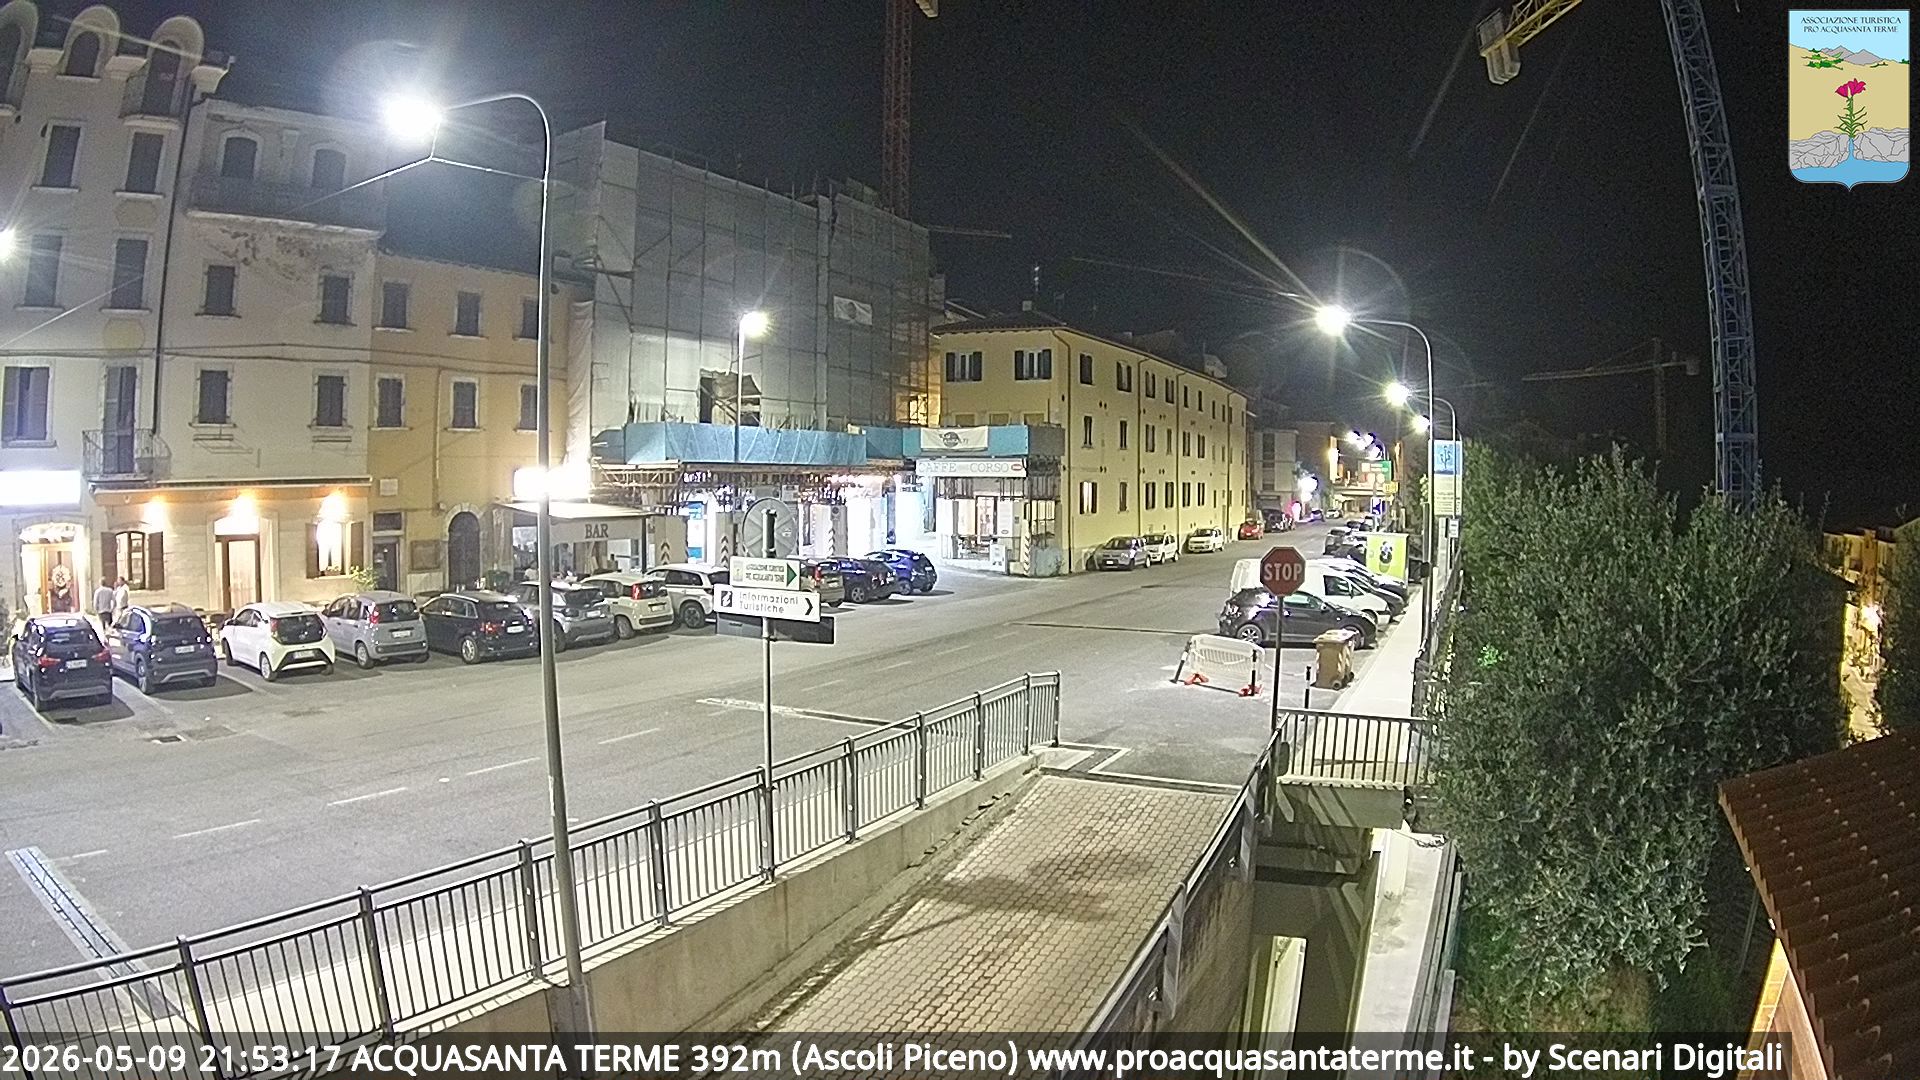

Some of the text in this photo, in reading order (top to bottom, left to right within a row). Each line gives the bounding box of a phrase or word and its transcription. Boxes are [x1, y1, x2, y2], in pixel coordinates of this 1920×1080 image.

[969, 462, 1009, 473] CORSO
[585, 523, 609, 539] BAR
[1263, 562, 1303, 581] STOP
[739, 591, 799, 606] Informazioni
[739, 600, 785, 614] Turistiche
